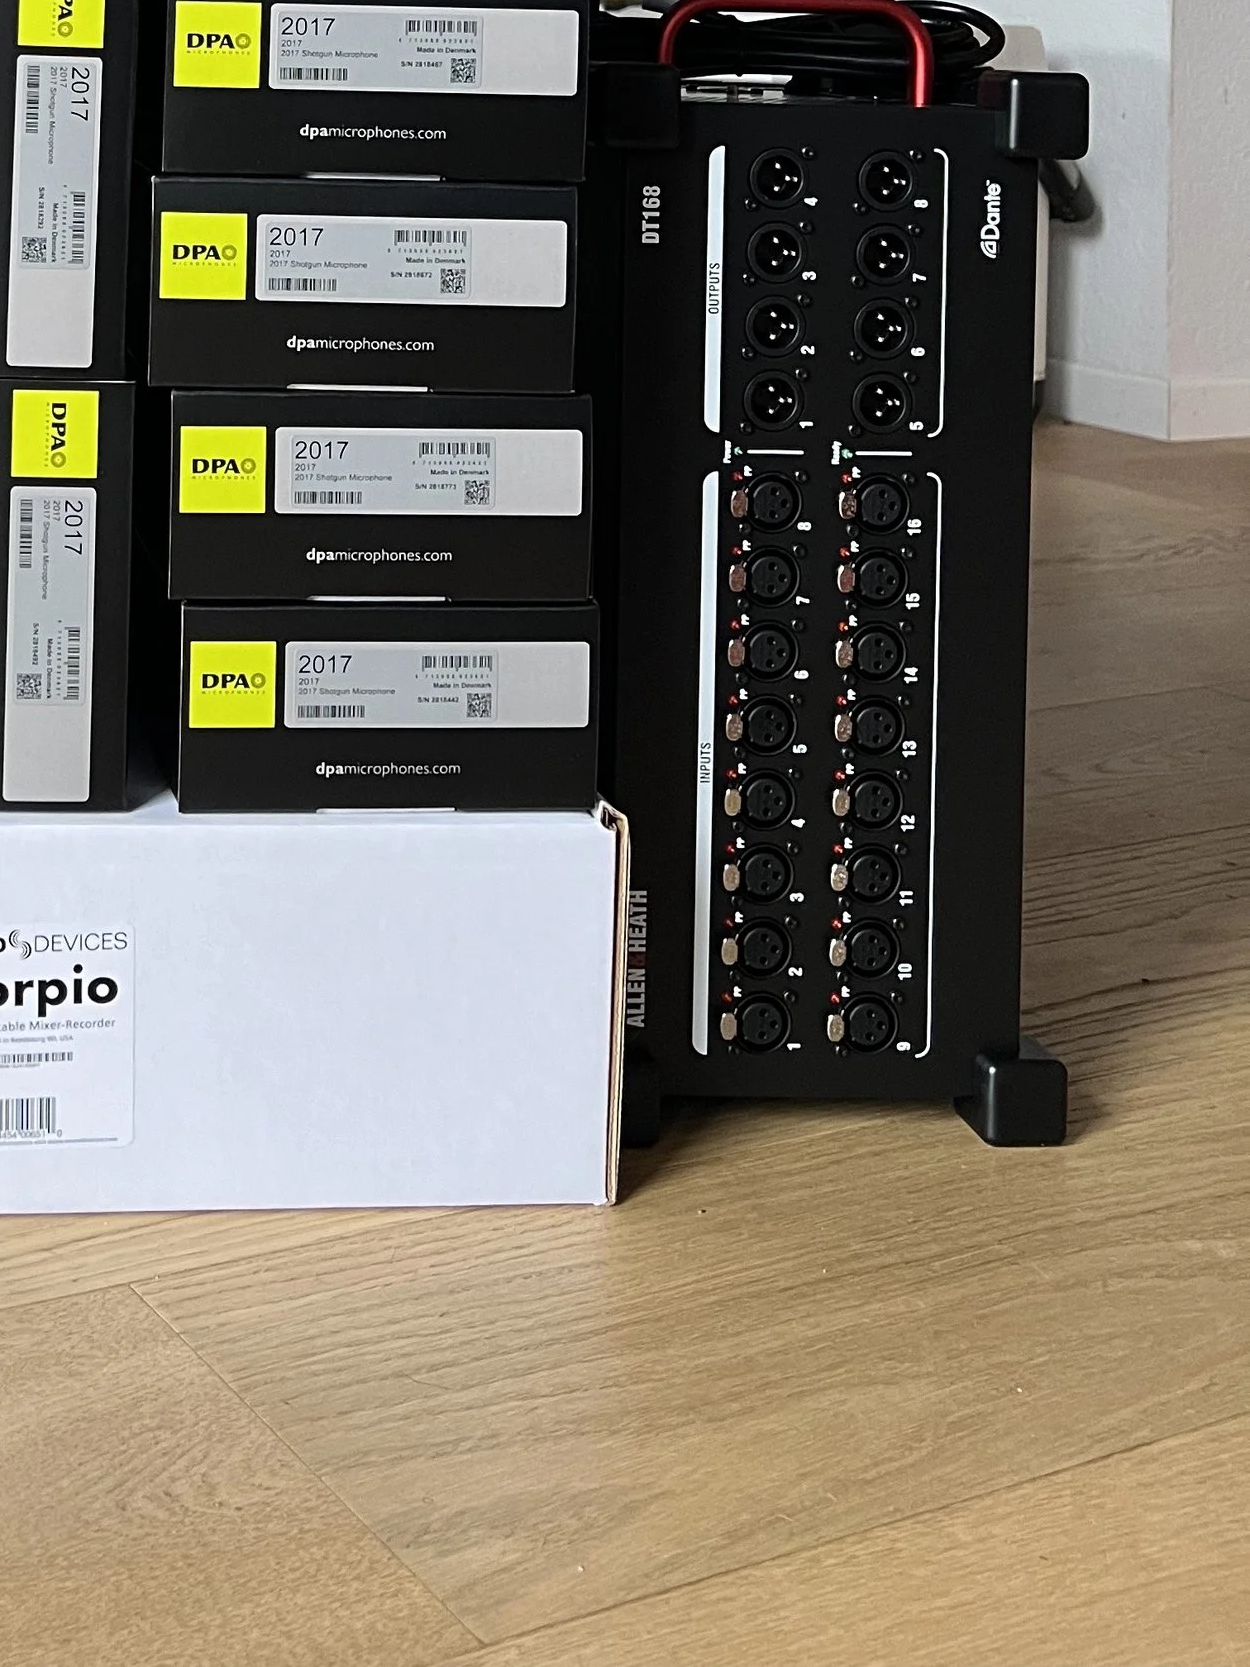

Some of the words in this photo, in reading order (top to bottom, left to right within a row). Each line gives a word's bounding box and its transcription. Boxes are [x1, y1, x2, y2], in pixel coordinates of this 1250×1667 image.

[282, 17, 335, 35] 2017
[188, 34, 234, 48] DPA
[60, 67, 68, 88] 2017
[71, 67, 89, 121] 2017
[300, 124, 446, 140] dpamicrophones.com
[804, 197, 818, 206] 4
[914, 200, 928, 208] 8
[981, 183, 1001, 236] Dante
[642, 186, 660, 243] DT168
[270, 227, 323, 246] 2017
[173, 245, 220, 259] DPA
[270, 249, 290, 258] 2017
[802, 271, 816, 280] 3
[913, 273, 926, 282] 7
[708, 262, 720, 314] OUTPUTS
[287, 335, 434, 352] dpamicrophones.com
[801, 346, 815, 354] 2
[911, 347, 925, 356] 6
[51, 403, 66, 450] DPA
[909, 421, 923, 430] 5
[296, 441, 348, 459] 2017
[193, 459, 240, 473] DPA
[295, 463, 316, 471] 2017
[316, 474, 347, 482] Shotgun
[349, 473, 392, 482] Microphone
[53, 500, 61, 521] 2017
[64, 500, 83, 555] 2017
[306, 548, 452, 564] dpamicrophones.com
[299, 655, 352, 673] 2017
[203, 674, 249, 688] DPA
[316, 762, 460, 778] dpamicrophones.com
[701, 742, 711, 783] INPUTS
[34, 932, 128, 953] DEVICES
[30, 1018, 115, 1030] Mixer-Recorder
